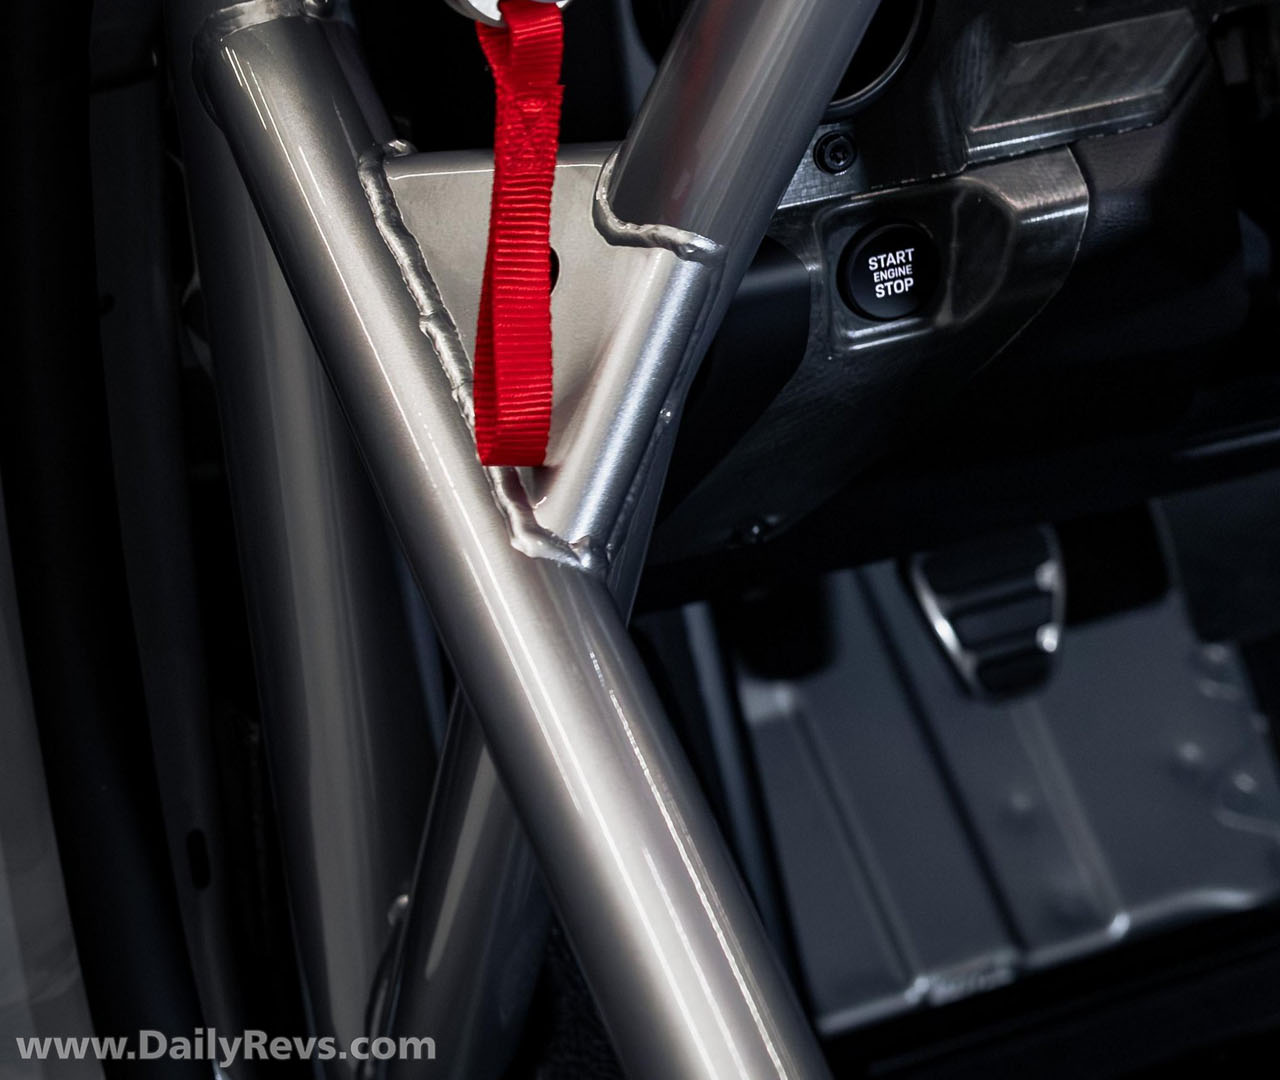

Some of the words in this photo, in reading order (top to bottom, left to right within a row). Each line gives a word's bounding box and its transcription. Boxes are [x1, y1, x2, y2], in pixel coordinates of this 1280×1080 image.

[868, 248, 915, 271] START
[873, 264, 913, 283] ENGINE
[875, 277, 914, 298] STOP
